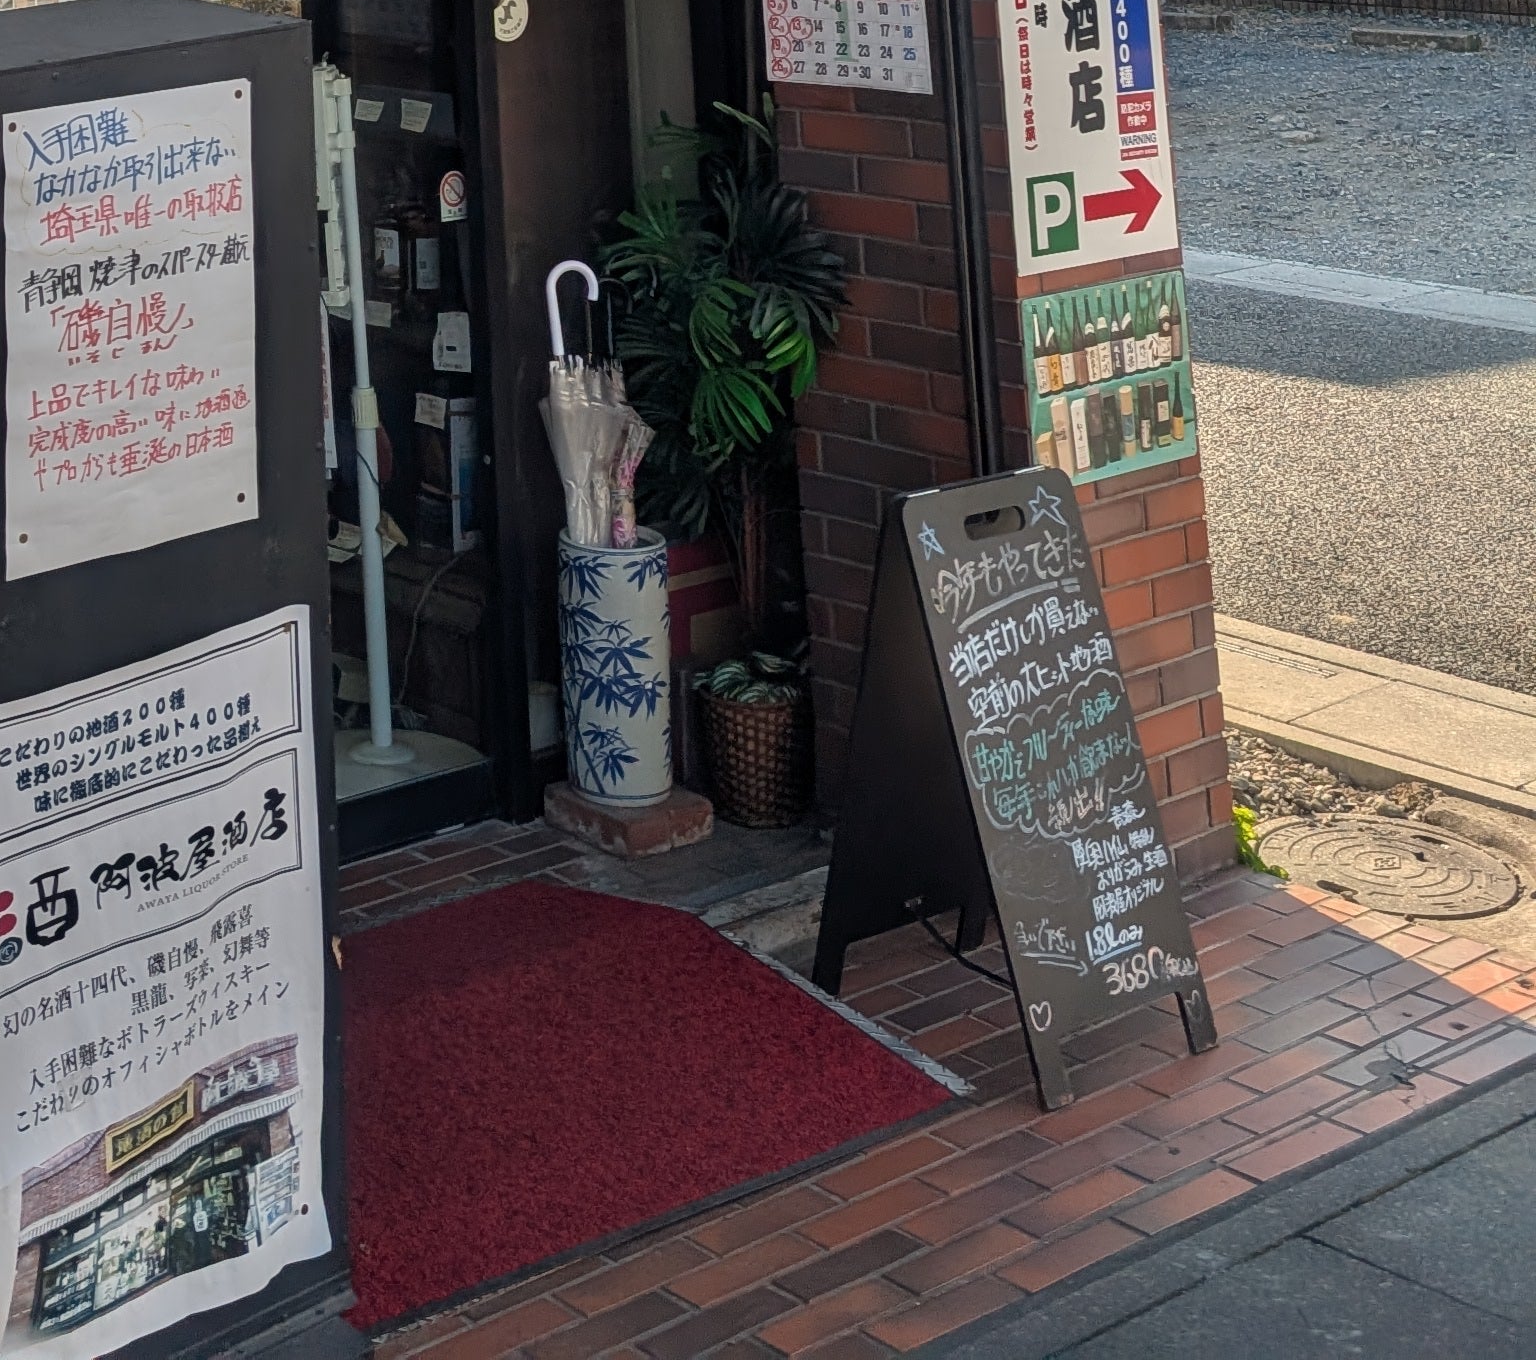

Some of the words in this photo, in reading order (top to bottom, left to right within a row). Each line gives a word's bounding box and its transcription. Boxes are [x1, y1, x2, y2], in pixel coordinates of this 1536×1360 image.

[813, 20, 823, 32] 14
[835, 21, 846, 34] 15
[857, 23, 868, 35] 16
[880, 24, 890, 37] 17
[902, 26, 913, 38] 18
[878, 3, 888, 15] 10
[900, 4, 910, 16] 11
[792, 40, 804, 52] 20
[815, 41, 825, 54] 21
[835, 43, 848, 56] 22
[858, 44, 870, 57] 23
[880, 46, 893, 59] 24
[903, 48, 916, 61] 25
[793, 61, 805, 73] 27
[815, 63, 827, 75] 28
[837, 64, 849, 77] 29
[859, 66, 871, 79] 30
[882, 68, 893, 81] 31
[22, 107, 137, 171] 入手困難
[1120, 132, 1157, 147] WARNING
[34, 136, 236, 205] なかなか取引出来ない
[39, 174, 242, 246] 埼玉県唯一の取扱店
[1033, 180, 1072, 251] P
[90, 788, 289, 911] 阿波屋酒店
[136, 893, 180, 913] AWAYA
[182, 873, 221, 899] LIQUOR
